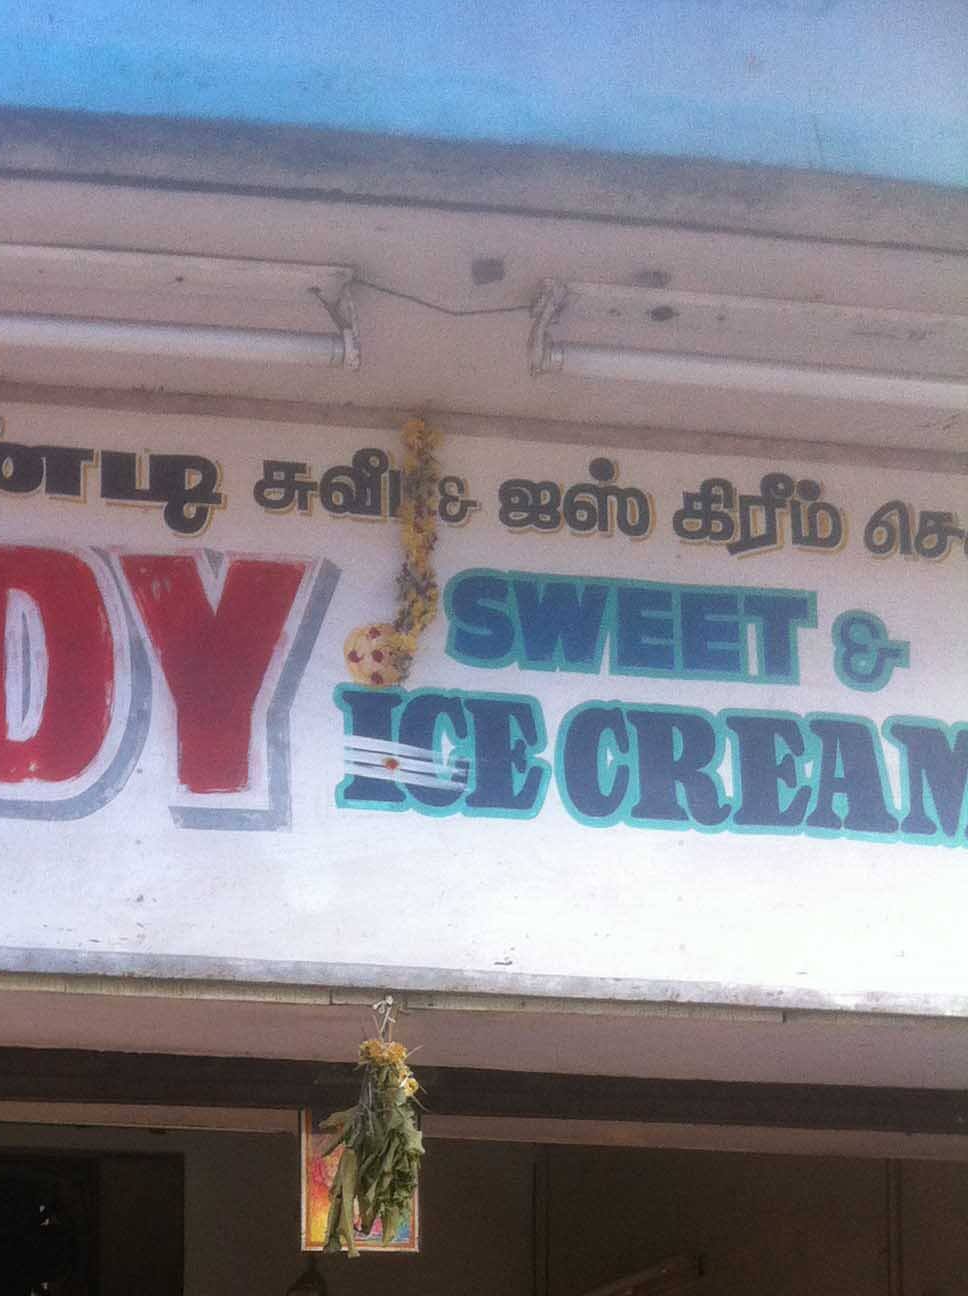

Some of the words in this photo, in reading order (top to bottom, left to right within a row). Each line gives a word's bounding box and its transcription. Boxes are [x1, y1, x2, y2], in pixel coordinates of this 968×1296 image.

[254, 448, 405, 518] சுவீ
[673, 472, 843, 556] கிரீம்
[444, 567, 818, 684] SWEET
[831, 609, 910, 692] &
[334, 684, 552, 818] ICE
[559, 699, 968, 848] CREAM
